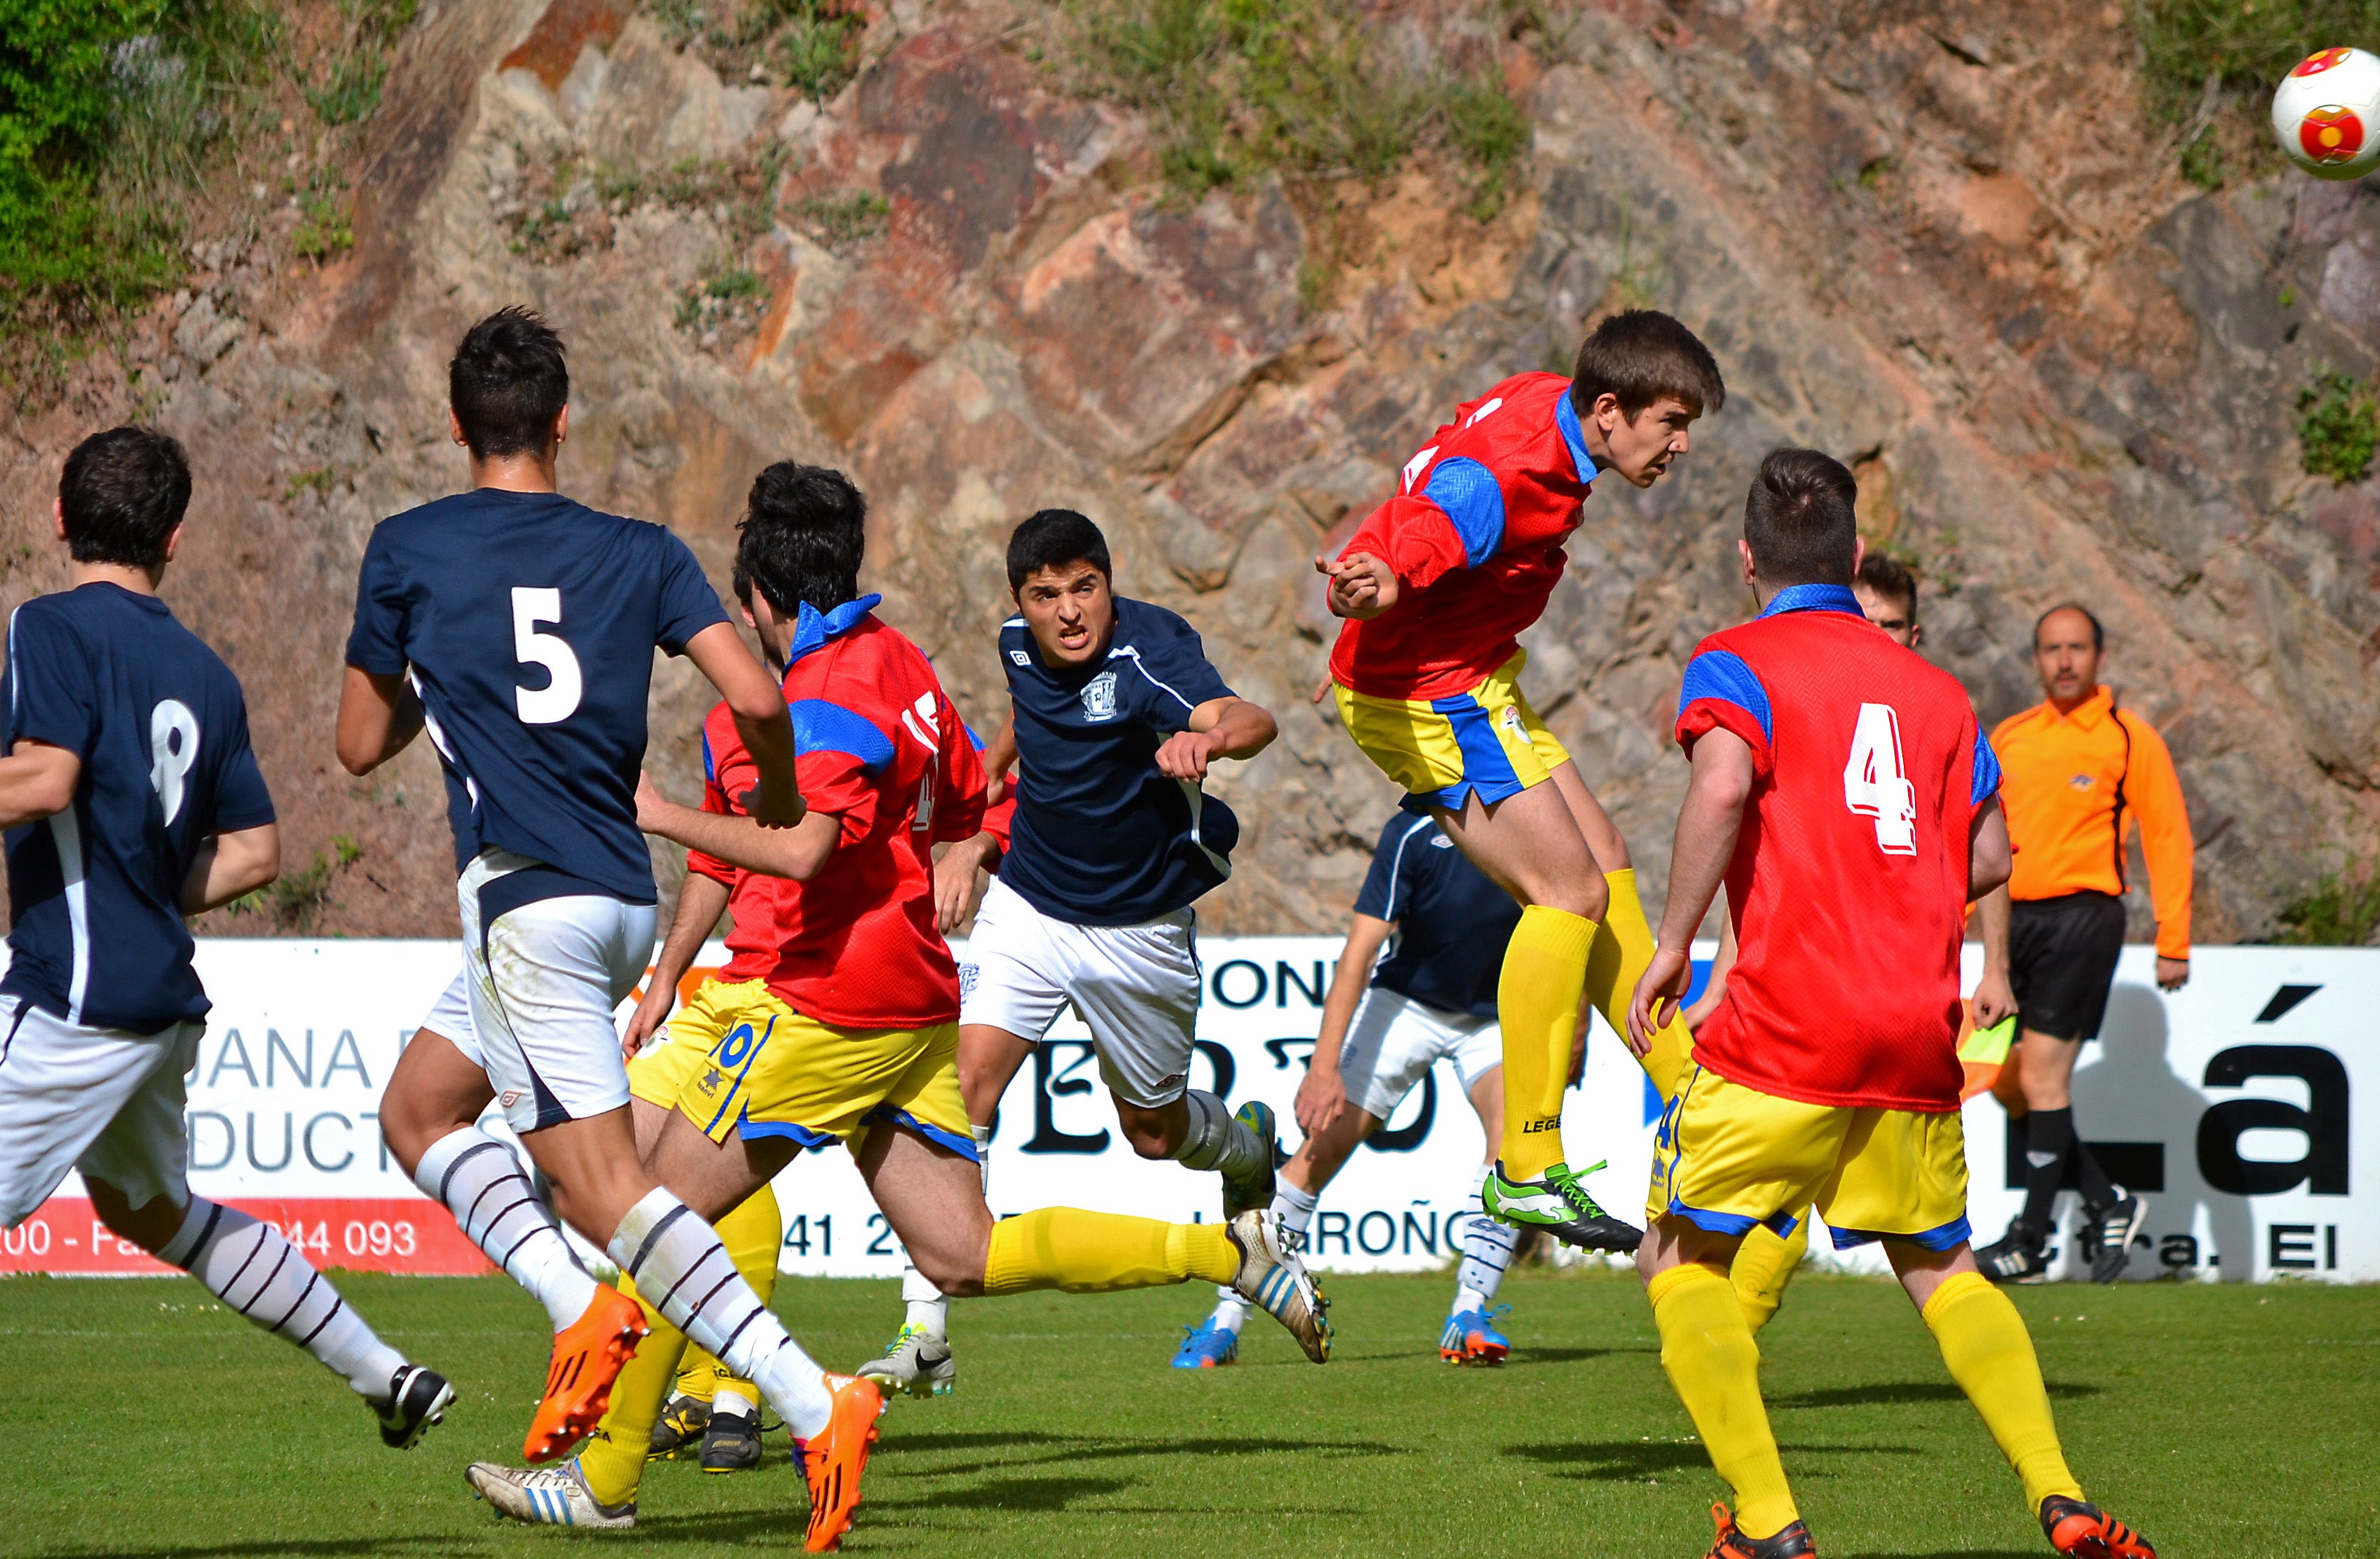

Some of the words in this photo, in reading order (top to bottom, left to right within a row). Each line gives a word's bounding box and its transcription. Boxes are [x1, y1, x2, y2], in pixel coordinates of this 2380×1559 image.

[511, 586, 582, 724] 5
[149, 698, 200, 828] 9
[1843, 702, 1917, 856] 4
[0, 1220, 51, 1256] 00
[92, 1220, 149, 1255] Fa
[344, 1220, 417, 1257] 093
[2268, 1224, 2336, 1270] El
